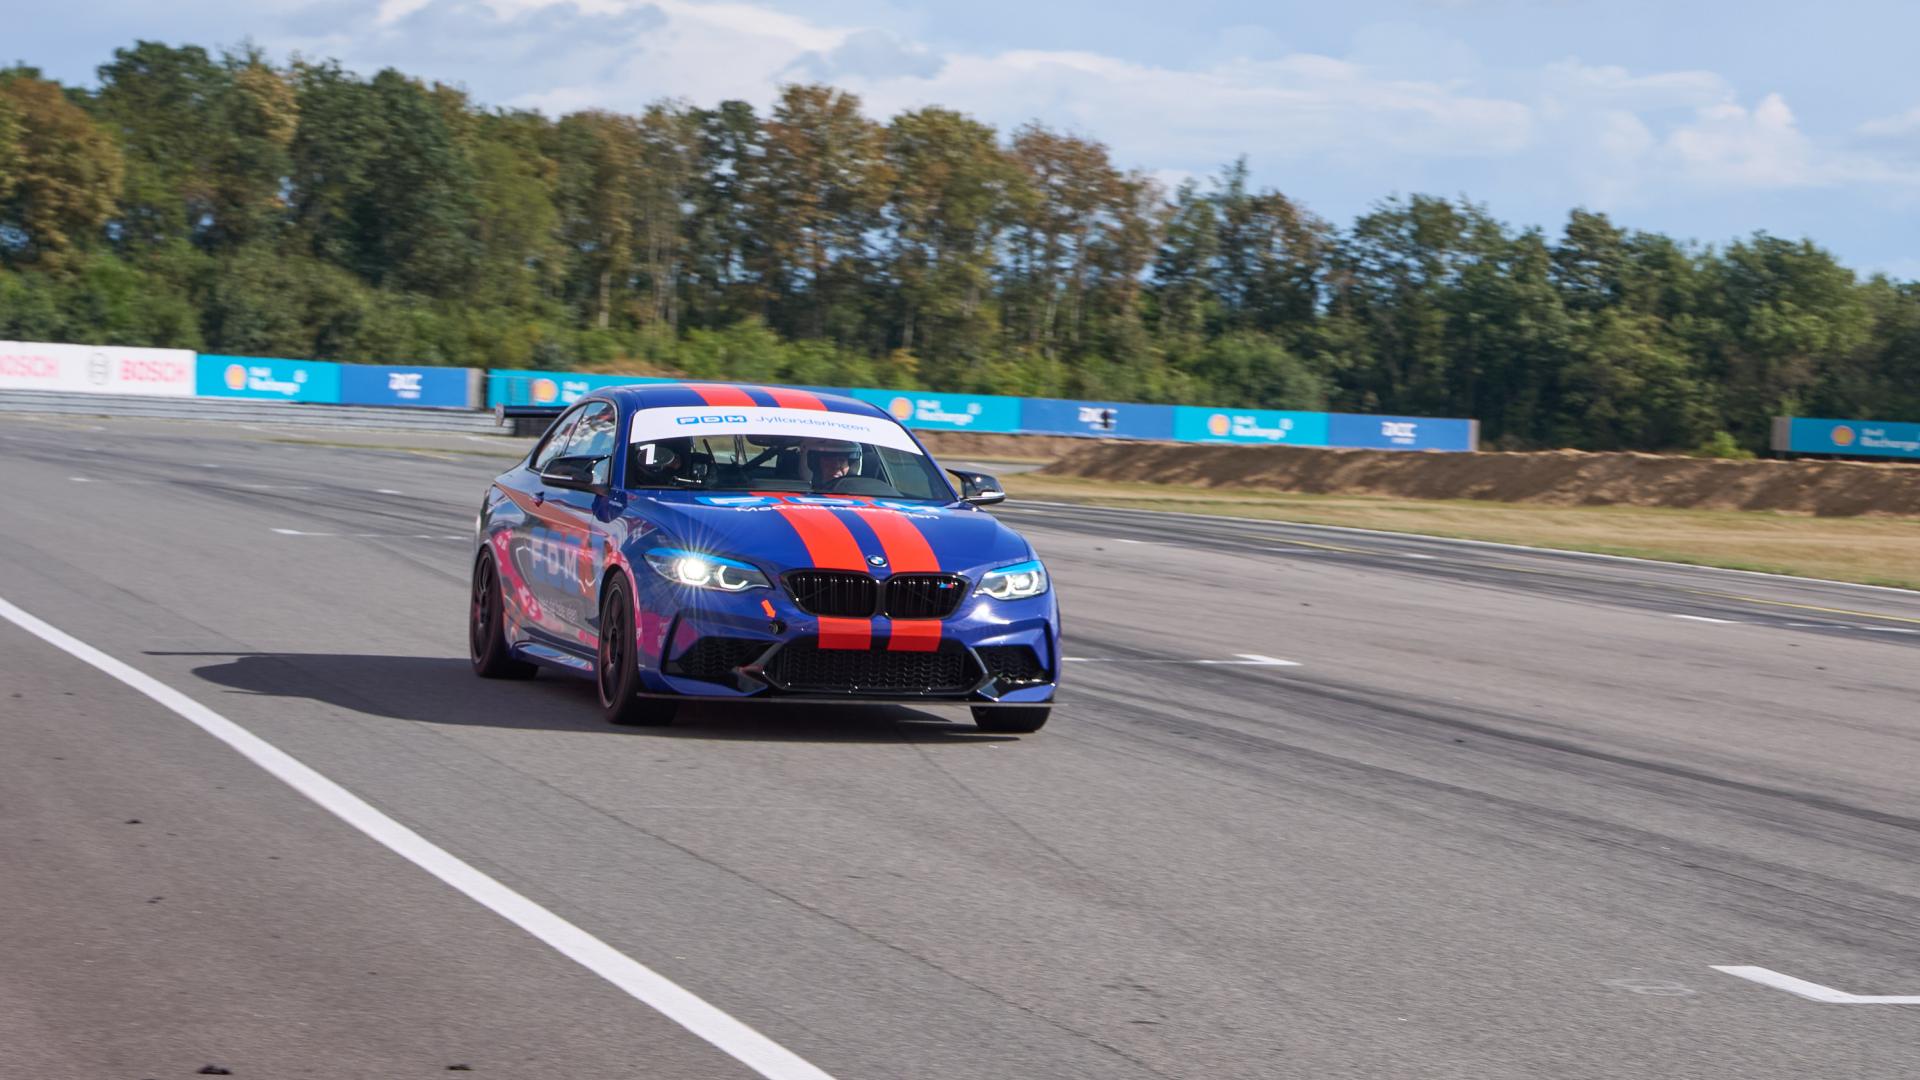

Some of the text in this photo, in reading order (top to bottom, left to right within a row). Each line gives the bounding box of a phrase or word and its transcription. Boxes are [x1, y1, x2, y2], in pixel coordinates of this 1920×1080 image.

[120, 358, 187, 381] BOSCH
[678, 416, 746, 424] FDM
[640, 444, 655, 464] 1
[531, 539, 577, 580] FDM
